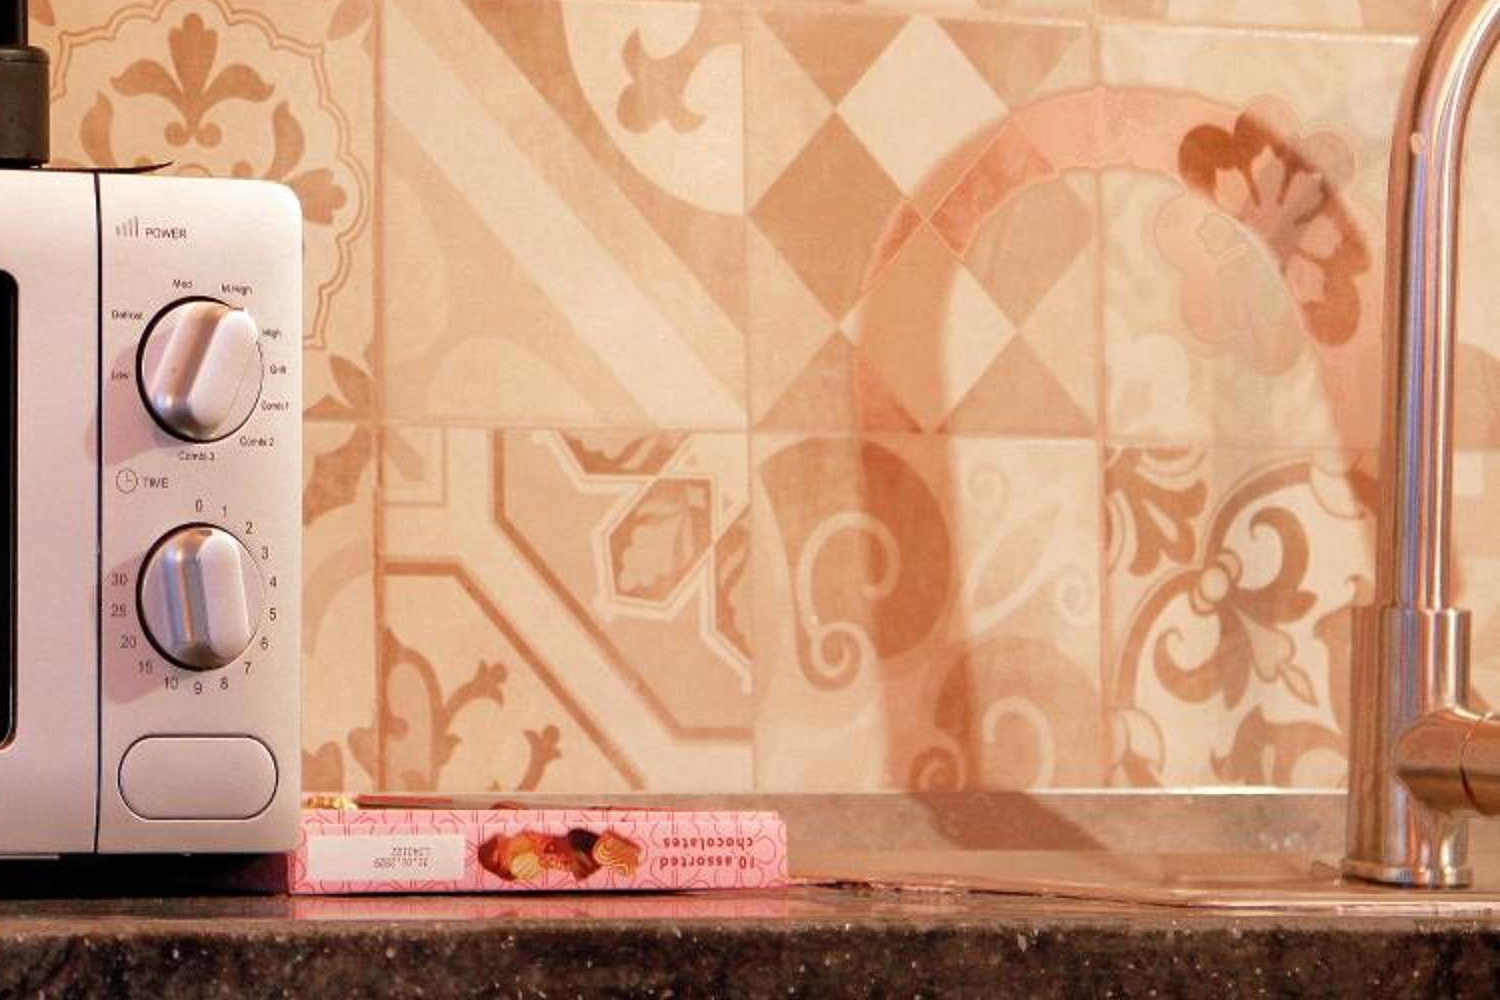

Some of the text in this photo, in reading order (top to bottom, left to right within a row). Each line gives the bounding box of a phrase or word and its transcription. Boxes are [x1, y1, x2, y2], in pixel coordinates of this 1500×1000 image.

[145, 227, 187, 240] POWER
[173, 279, 193, 289] Med
[143, 478, 169, 489] TIME
[195, 500, 203, 512] 0
[222, 506, 227, 516] 1
[245, 522, 253, 534] 2
[261, 547, 269, 559] 3
[111, 573, 128, 586] 30
[269, 576, 277, 587] 4
[111, 604, 127, 617] 25
[269, 608, 277, 620] 5
[120, 635, 137, 649] 20
[261, 637, 269, 650] 6
[139, 661, 153, 674] 15
[244, 662, 251, 674] 7
[165, 676, 179, 690] 10
[194, 682, 203, 694] 9
[220, 676, 229, 690] 8
[663, 837, 753, 851] chocolates
[660, 856, 755, 870] 10 assorted
